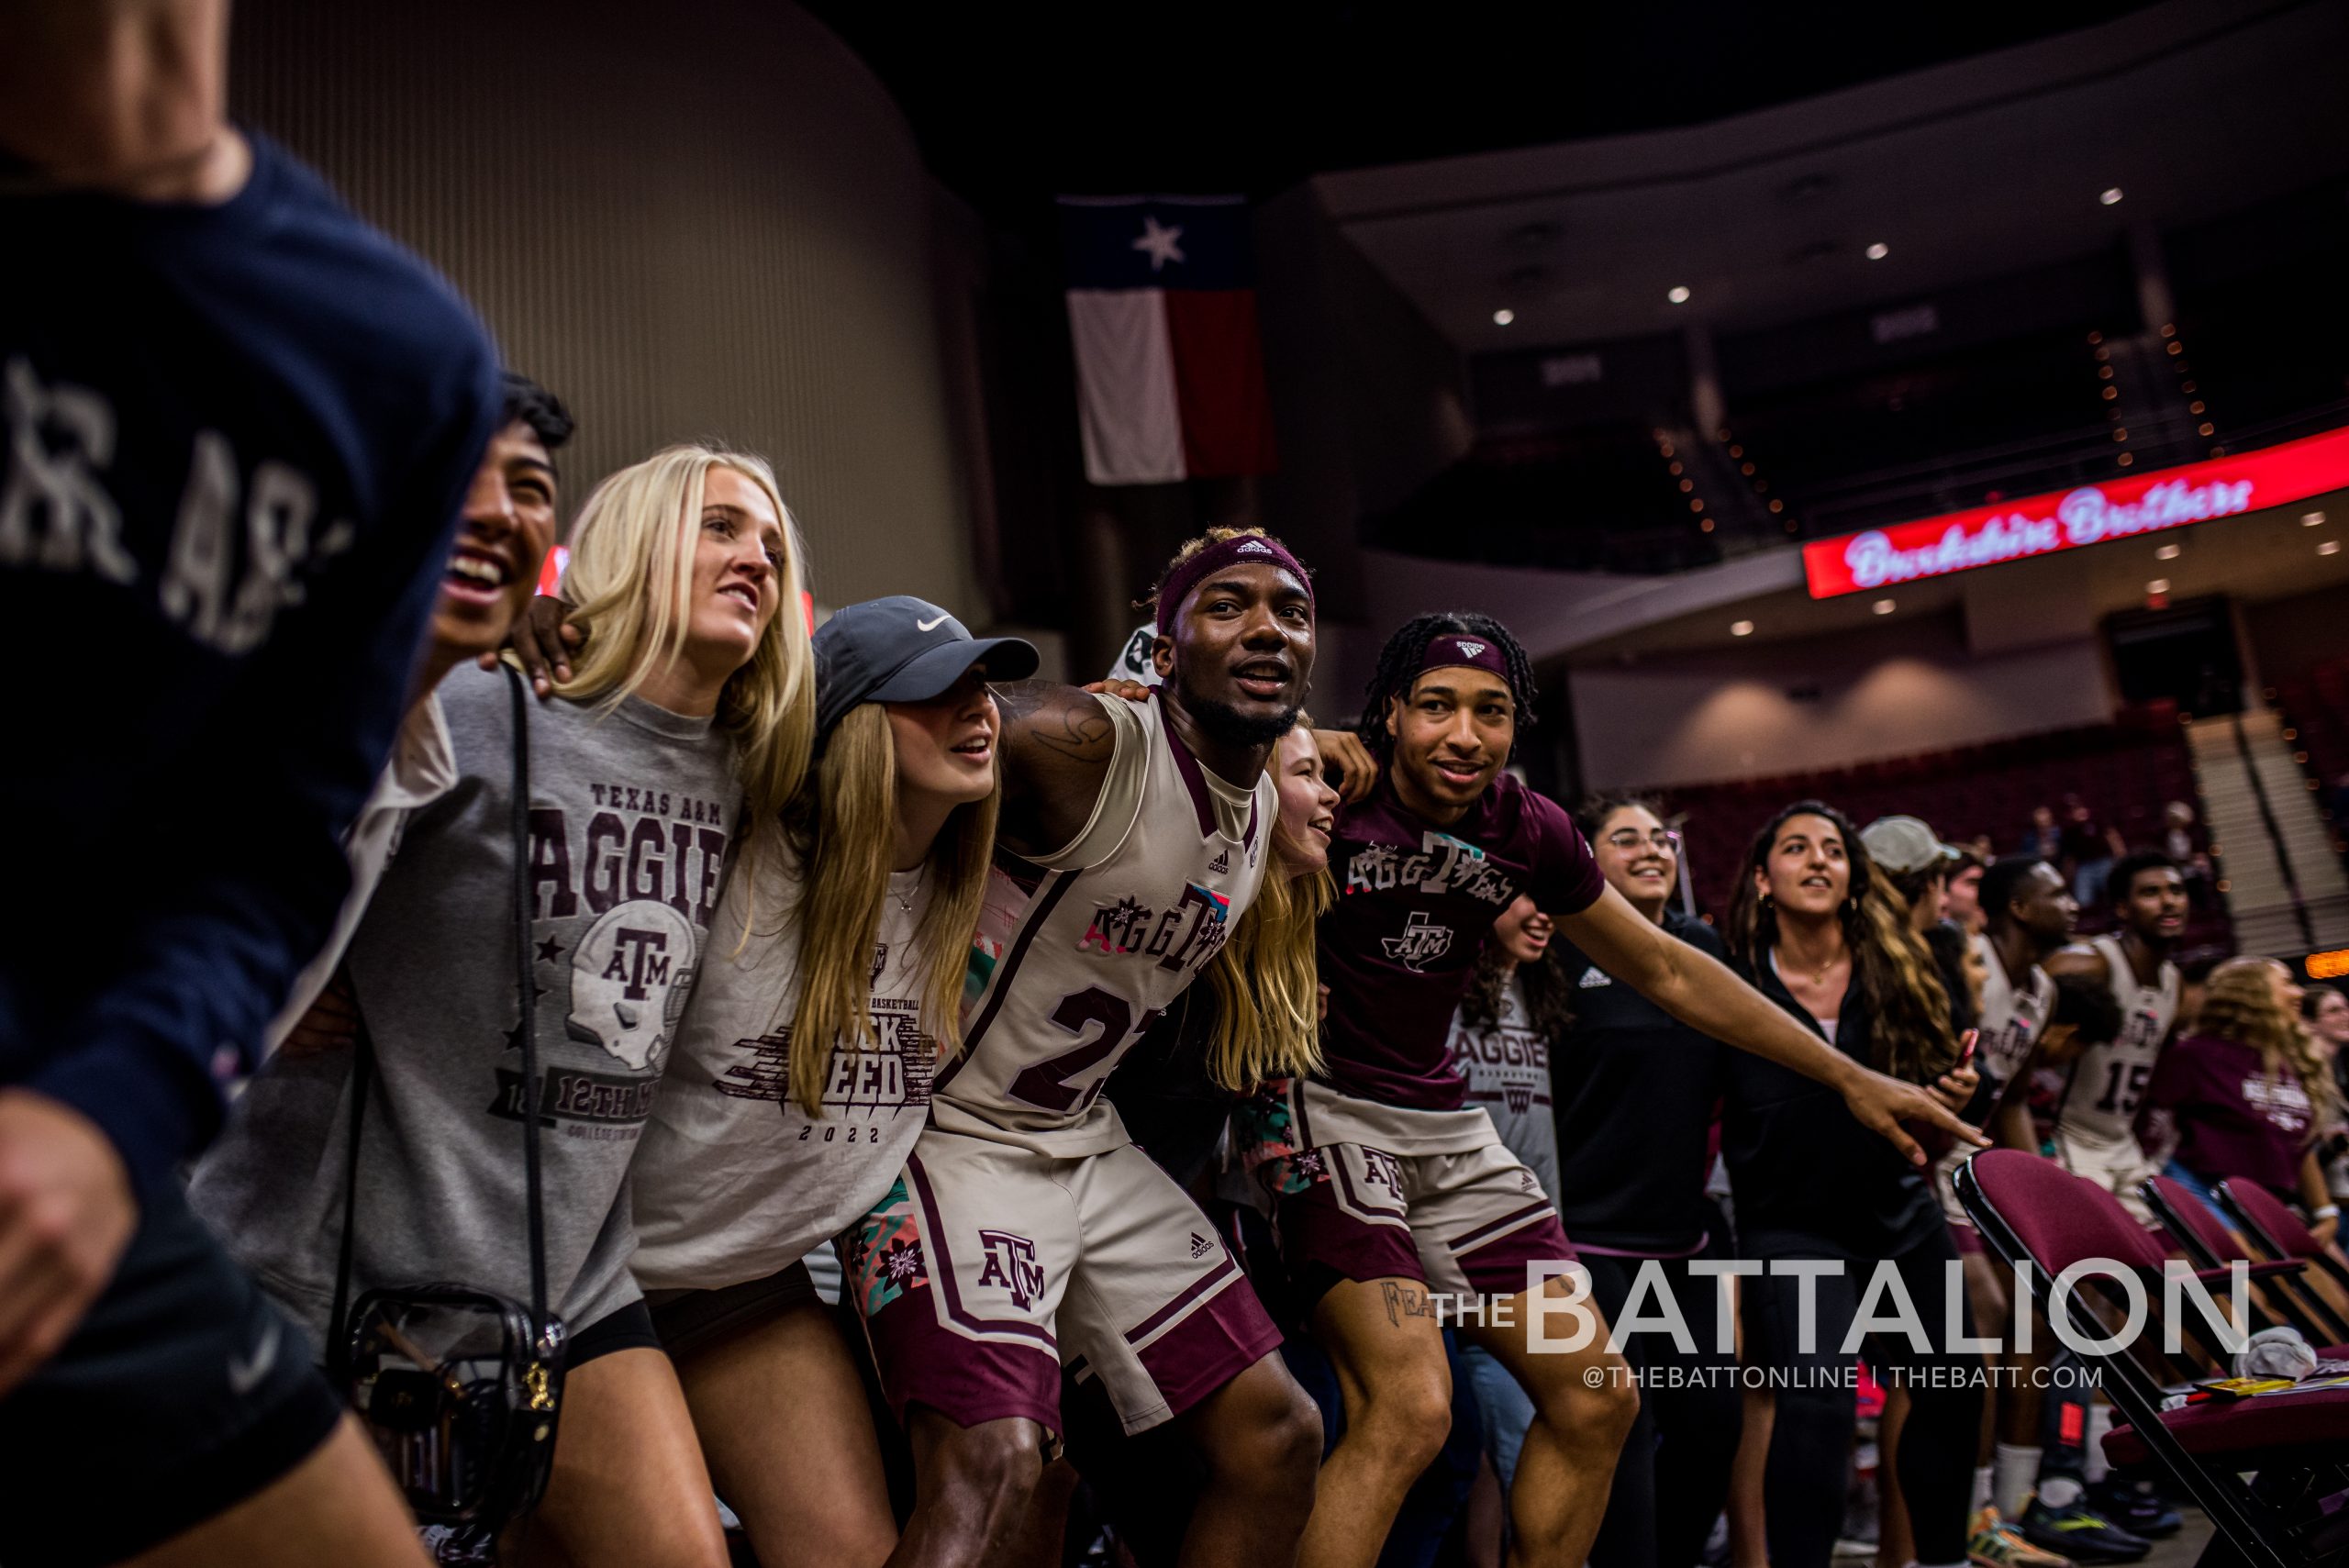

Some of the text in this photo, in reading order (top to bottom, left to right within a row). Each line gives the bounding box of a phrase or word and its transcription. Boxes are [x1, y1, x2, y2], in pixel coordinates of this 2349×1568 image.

[2057, 478, 2253, 545] Brothers
[591, 784, 721, 826] TEXAS A&M
[1208, 862, 1229, 874] adidas
[871, 997, 919, 1010] BASKETBALL
[554, 1076, 633, 1119] 12TH
[2096, 1062, 2150, 1114] 15
[798, 1125, 878, 1143] 2022
[1191, 1240, 1215, 1259] adidas
